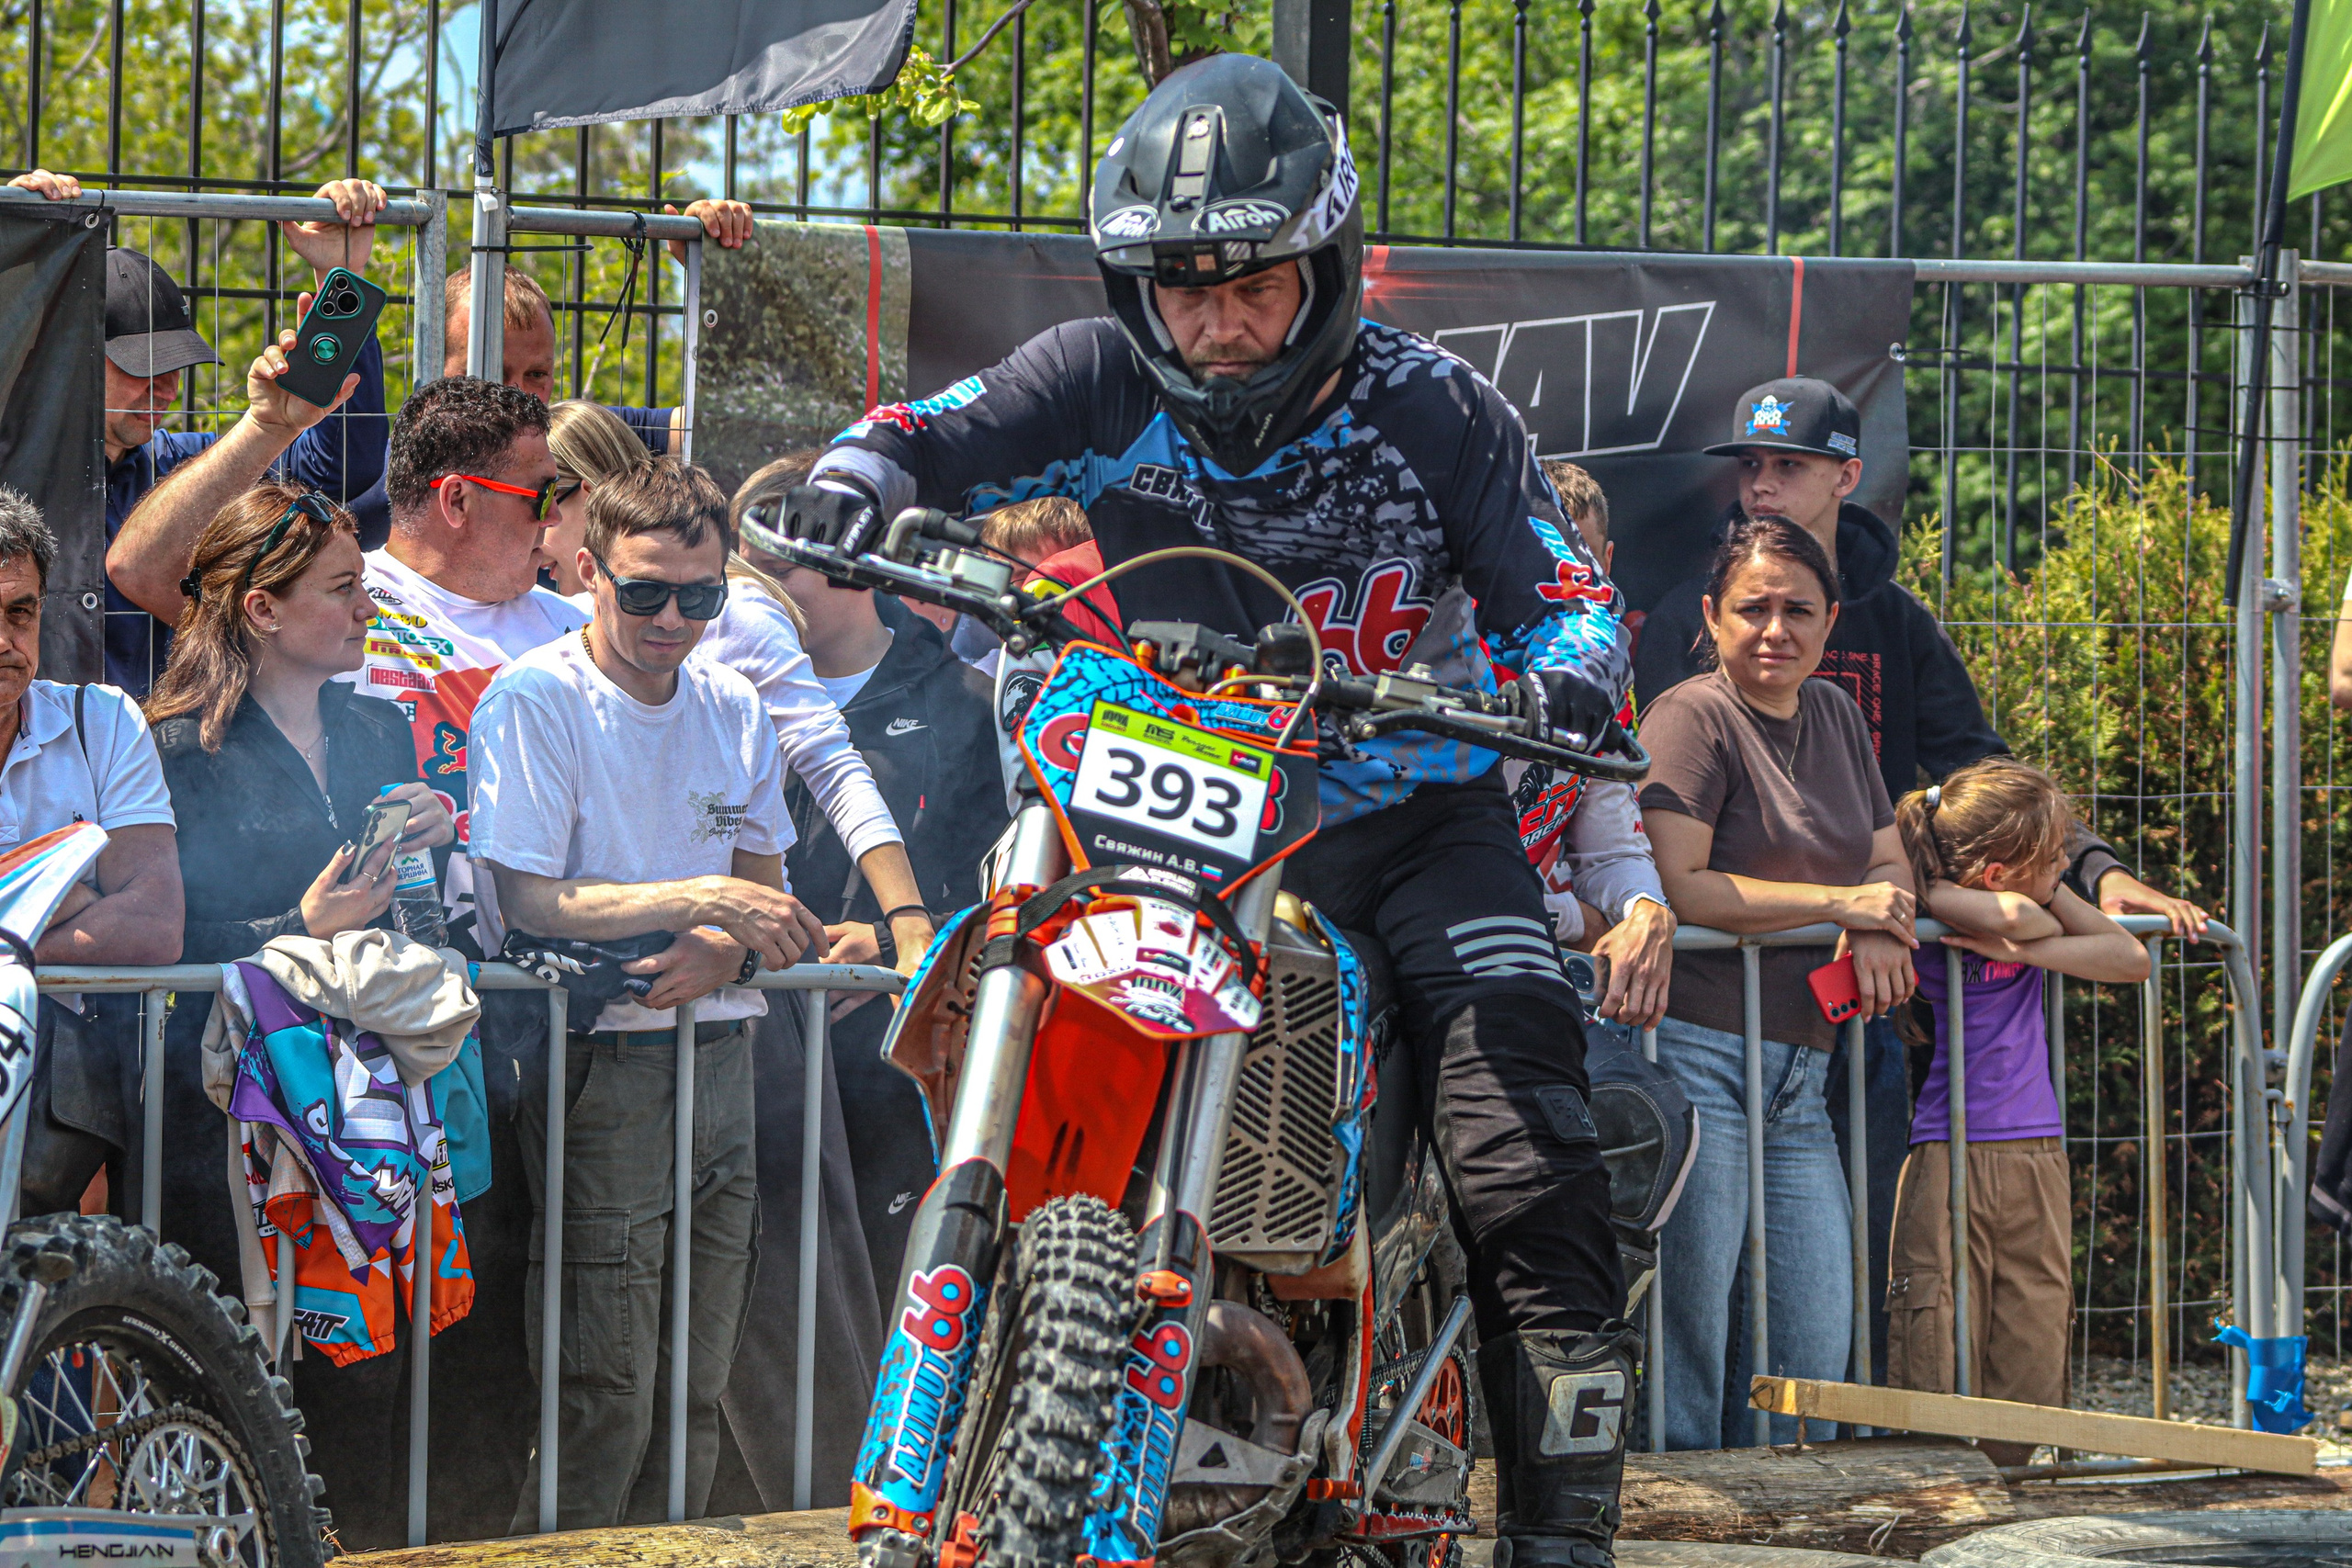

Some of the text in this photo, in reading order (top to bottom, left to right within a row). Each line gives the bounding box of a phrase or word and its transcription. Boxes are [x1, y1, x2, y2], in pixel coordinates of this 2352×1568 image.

[1102, 211, 1151, 238] Airoh
[1207, 203, 1282, 233] Airoh
[893, 716, 919, 728] NIKE
[1094, 747, 1243, 840] 393
[707, 803, 749, 816] Summer
[715, 815, 743, 828] Vibes
[1093, 833, 1201, 875] Свяжин А.В.
[398, 863, 424, 874] ГОРНАЯ
[121, 1314, 161, 1337] ENDURO
[156, 1329, 173, 1345] X
[890, 1264, 975, 1485] AZIMUT 66
[1124, 1320, 1193, 1551] AZIMUT 66
[59, 1543, 175, 1560] HENGJIAN
